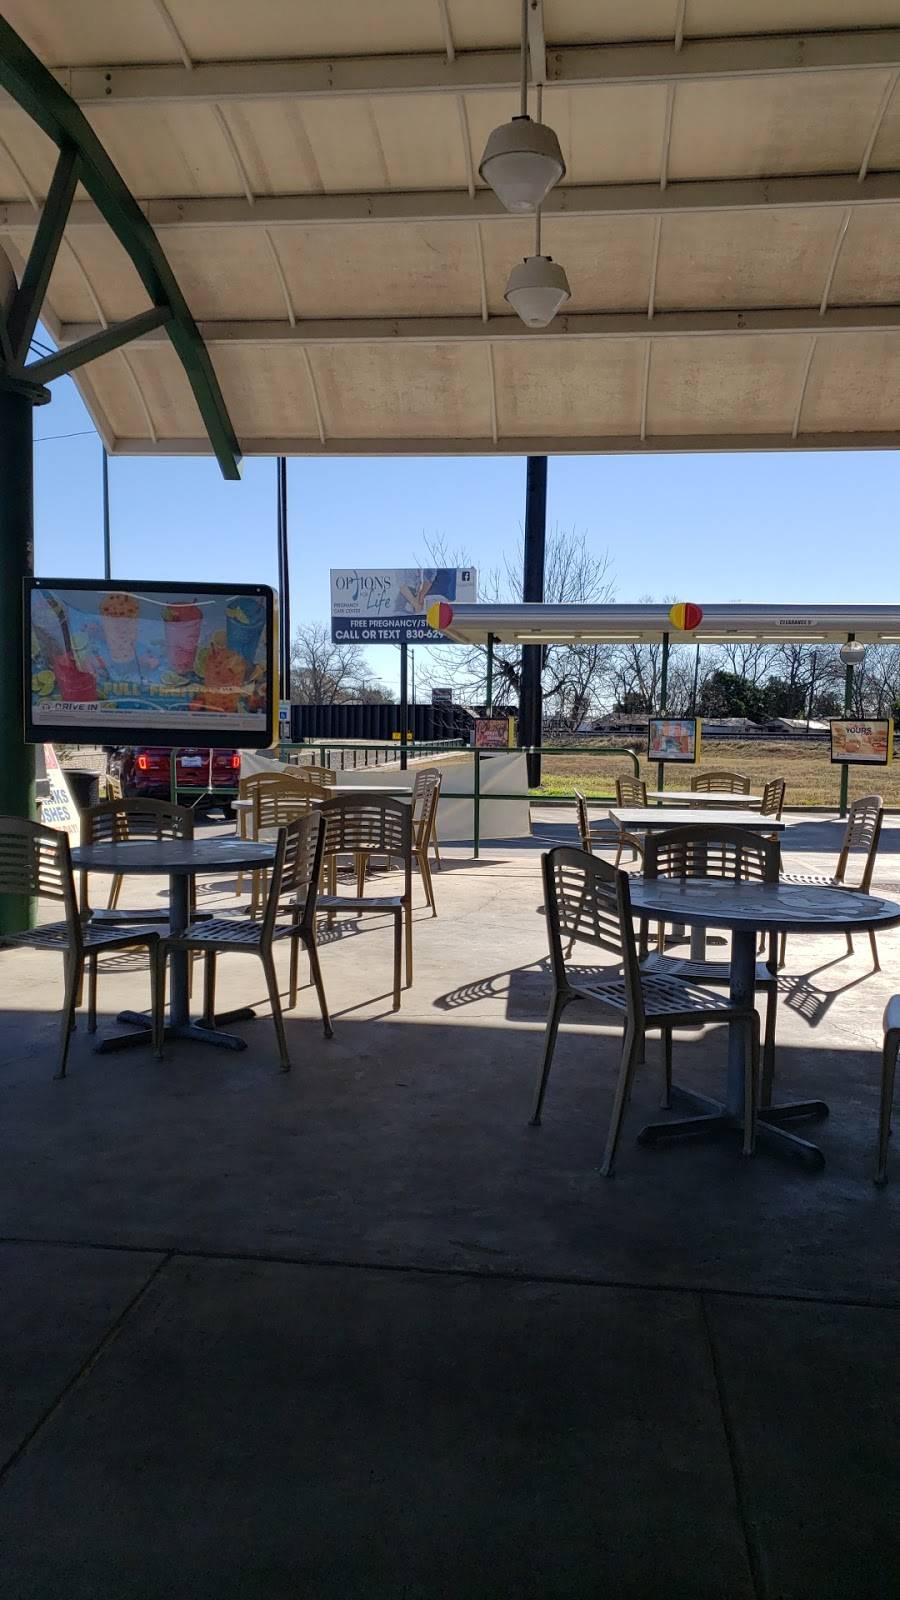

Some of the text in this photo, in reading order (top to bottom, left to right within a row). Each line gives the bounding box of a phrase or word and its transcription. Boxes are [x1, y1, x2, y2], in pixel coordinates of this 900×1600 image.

[335, 571, 391, 598] OPTIONS
[367, 588, 391, 615] Life
[350, 619, 367, 627] FREE
[335, 630, 359, 639] CALL
[361, 630, 376, 639] OR
[378, 629, 401, 639] TEXT
[55, 703, 98, 711] DRIVE IN
